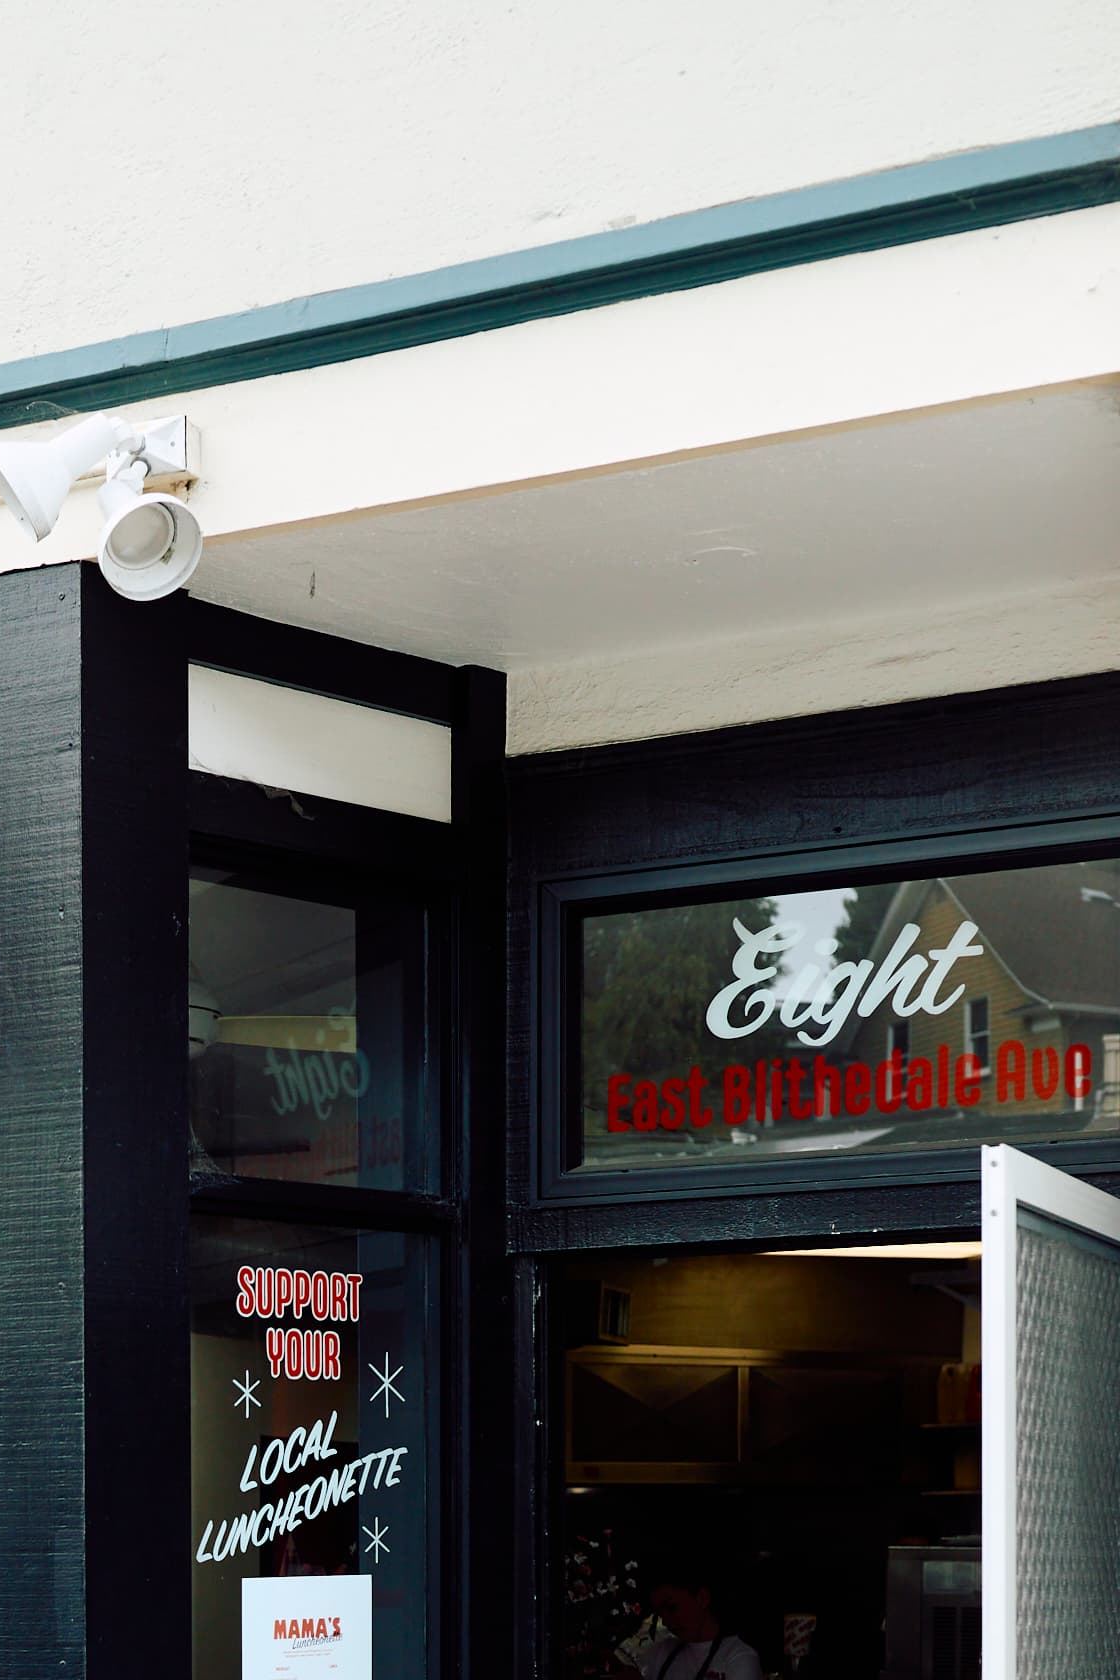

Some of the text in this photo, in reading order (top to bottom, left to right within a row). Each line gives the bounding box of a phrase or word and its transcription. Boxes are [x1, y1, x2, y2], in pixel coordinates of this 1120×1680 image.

[706, 916, 984, 1047] Eight
[606, 1039, 1093, 1133] East Blithedale Ave
[236, 1265, 364, 1323] SUPPORT
[265, 1327, 342, 1381] YOUR
[239, 1410, 338, 1493] LOCAL
[195, 1446, 409, 1564] LUNCHEONETTE
[273, 1617, 342, 1640] MAMA'S
